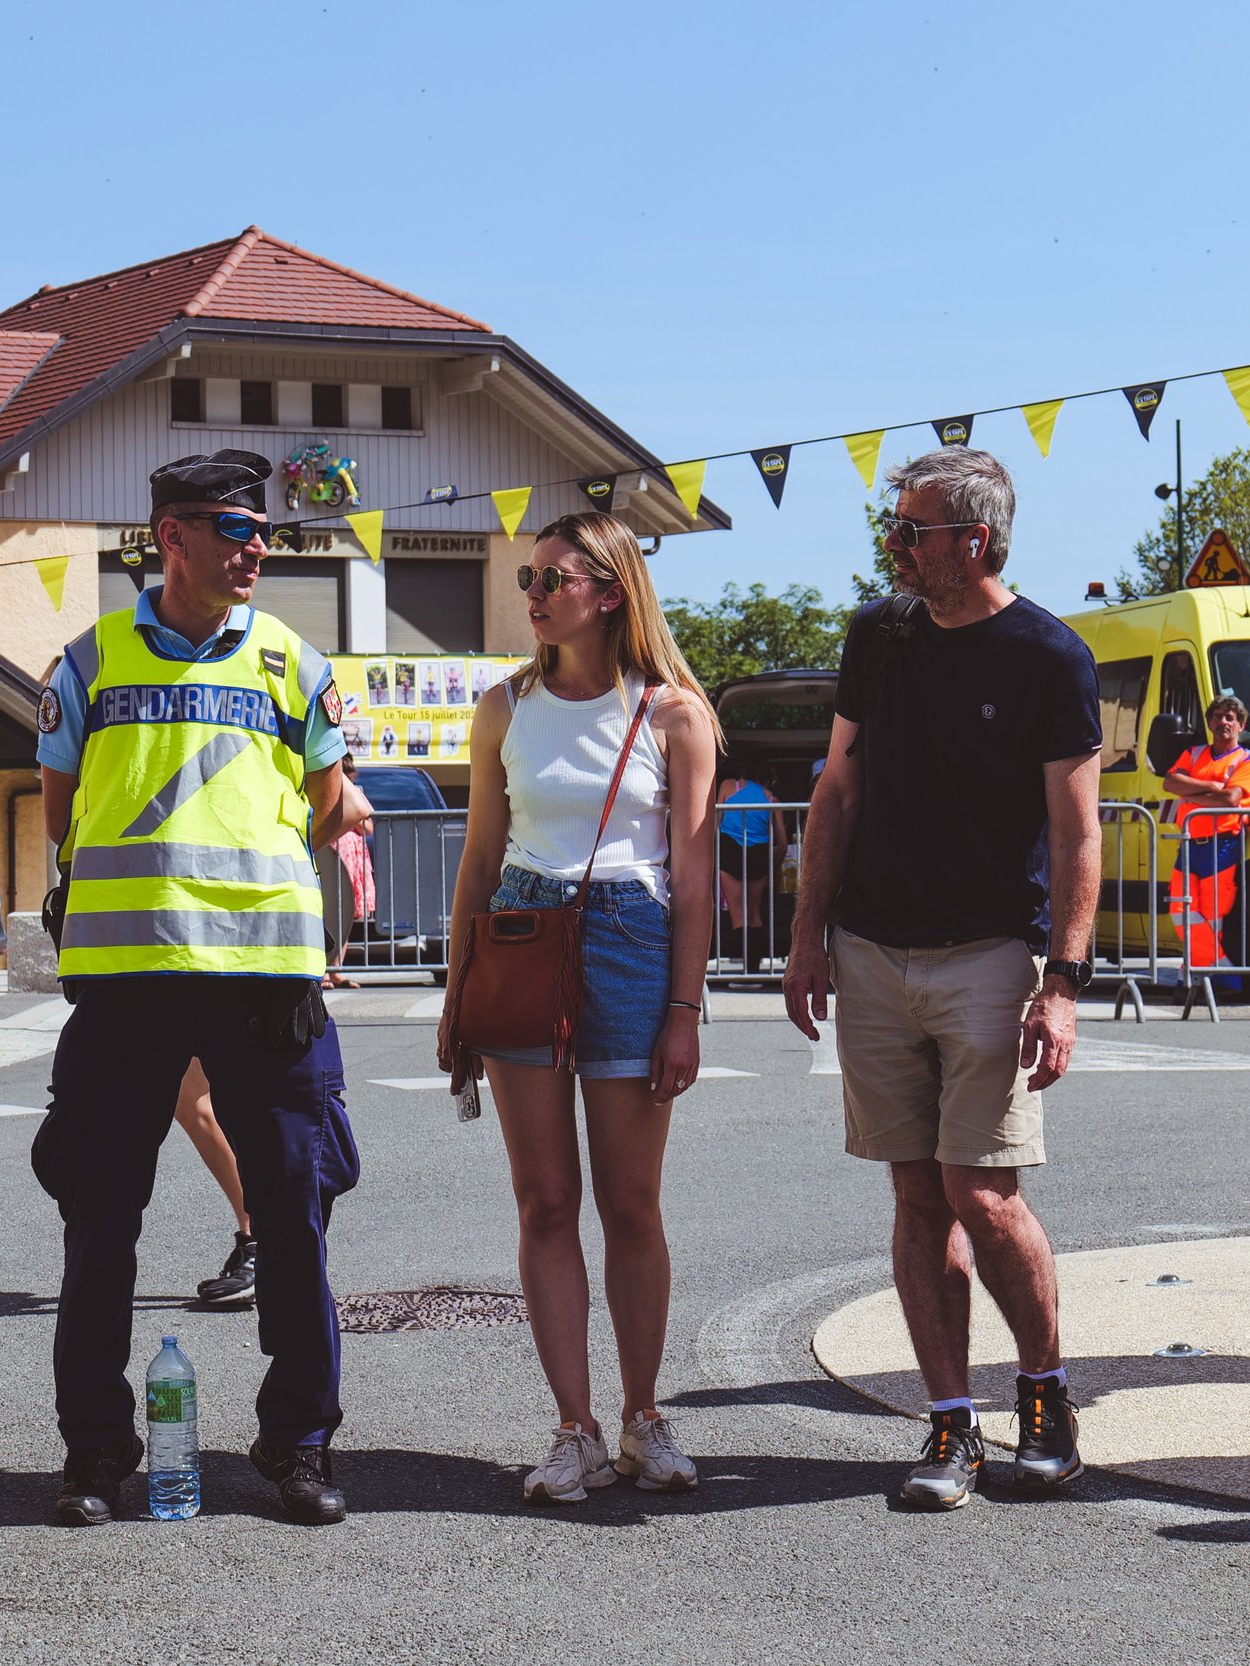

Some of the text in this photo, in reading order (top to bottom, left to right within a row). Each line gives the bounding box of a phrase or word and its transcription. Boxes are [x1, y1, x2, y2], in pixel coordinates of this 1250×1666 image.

[102, 687, 276, 732] GENDARMERIE
[383, 711, 395, 720] Le
[398, 711, 417, 720] Tour
[420, 711, 430, 720] 15
[431, 710, 458, 721] juillet
